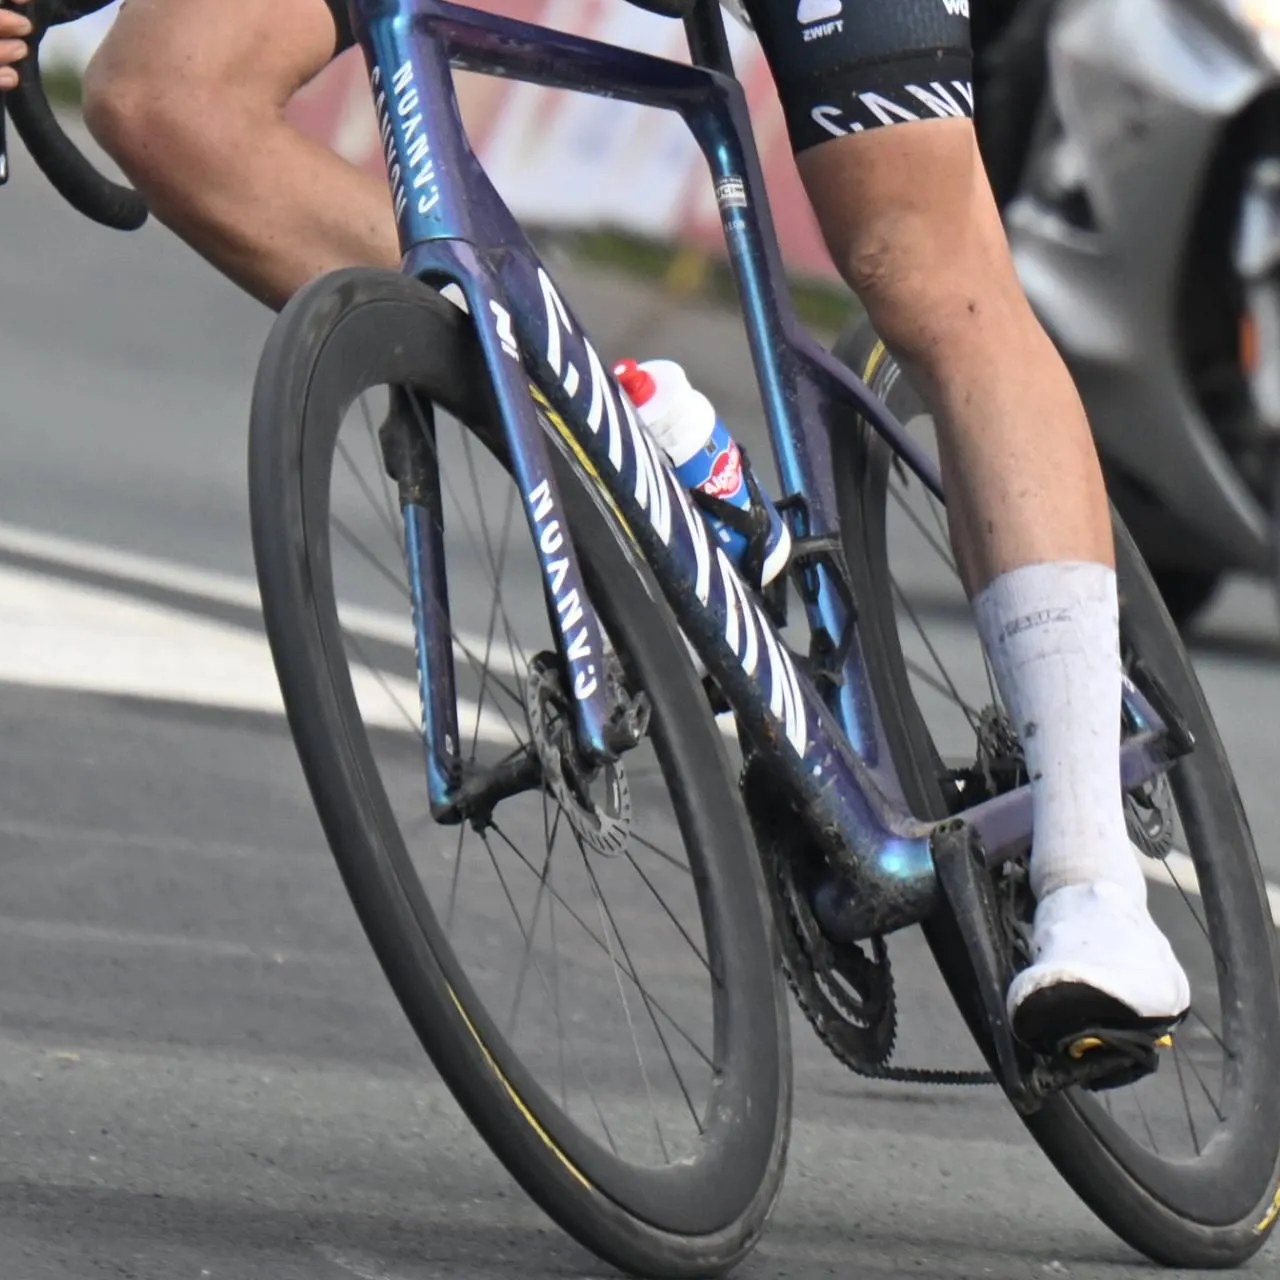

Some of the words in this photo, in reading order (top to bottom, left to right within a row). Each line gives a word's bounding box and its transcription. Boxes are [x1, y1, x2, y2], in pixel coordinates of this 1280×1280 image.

[801, 20, 845, 43] ZWIFT
[391, 59, 441, 214] CANYON
[528, 478, 598, 701] CANYON
[537, 266, 807, 760] CANYON
